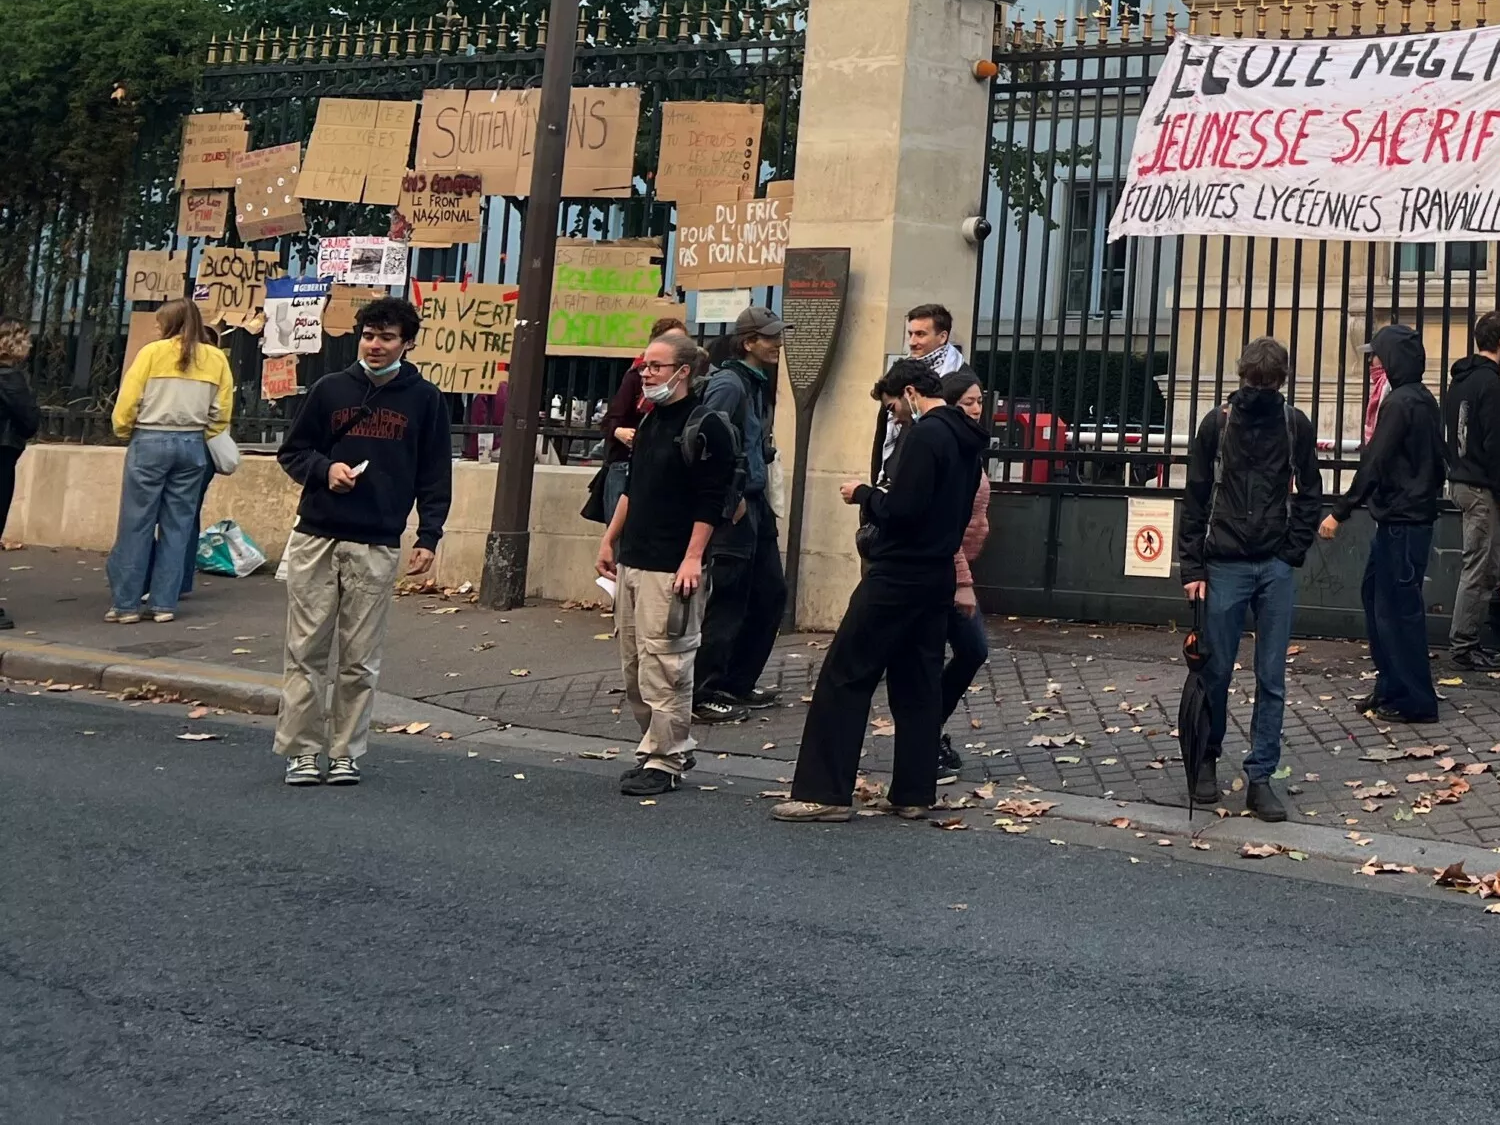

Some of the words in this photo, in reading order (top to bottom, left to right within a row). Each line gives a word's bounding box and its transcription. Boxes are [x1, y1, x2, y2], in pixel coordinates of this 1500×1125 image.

[324, 103, 406, 123] FINANCEZ
[433, 106, 514, 158] SOUTIEN
[688, 131, 736, 147] DÉTRUIS
[1138, 109, 1324, 175] JEUNESSE
[412, 195, 422, 206] LE
[430, 194, 463, 208] FRONT
[1253, 178, 1382, 232] LYCÉENNES
[413, 208, 474, 226] NASSIONAL
[716, 205, 736, 223] DU
[680, 226, 716, 243] POUR
[556, 249, 573, 266] ES
[581, 248, 611, 266] FEUX
[624, 251, 648, 268] DE
[679, 244, 699, 267] PAS
[709, 242, 747, 264] POUR
[209, 282, 261, 312] TOUT
[550, 293, 560, 310] A
[564, 293, 588, 312] FAIT
[595, 295, 624, 311] PEUR
[627, 296, 649, 310] AUX
[421, 297, 447, 320] EN
[457, 298, 516, 328] VERT
[293, 318, 308, 332] pas
[418, 327, 432, 346] T
[435, 327, 514, 355] CONTRE
